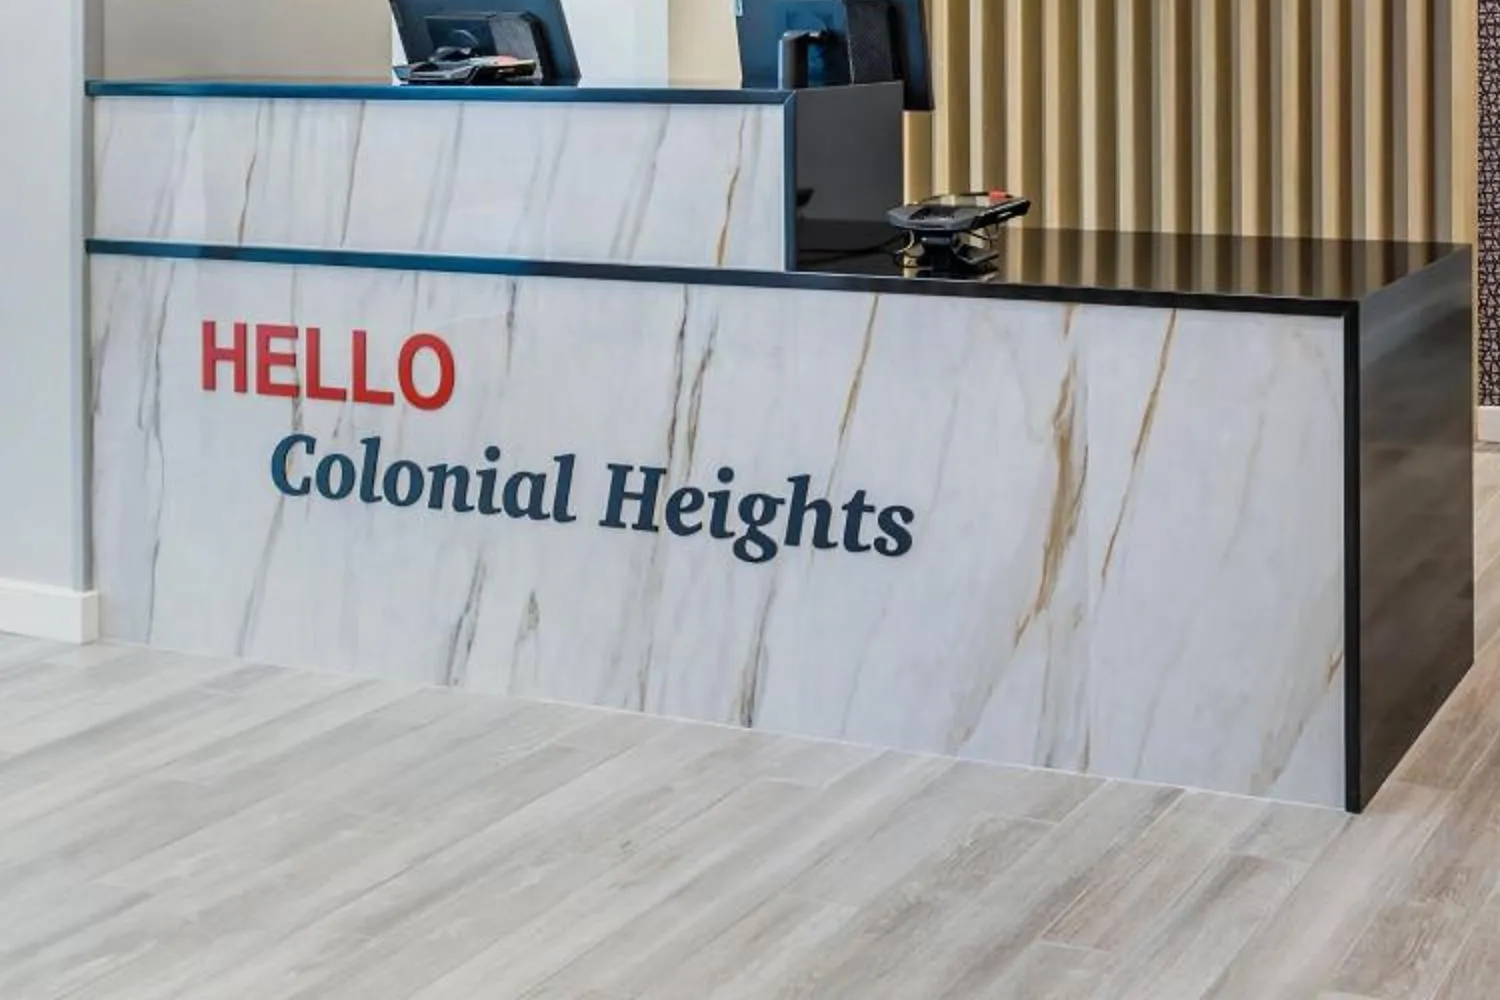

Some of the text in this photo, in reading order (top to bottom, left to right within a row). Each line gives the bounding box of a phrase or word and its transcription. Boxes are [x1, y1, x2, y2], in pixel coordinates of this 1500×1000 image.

[202, 320, 455, 411] HELLO
[271, 433, 914, 563] Colonial Heights
